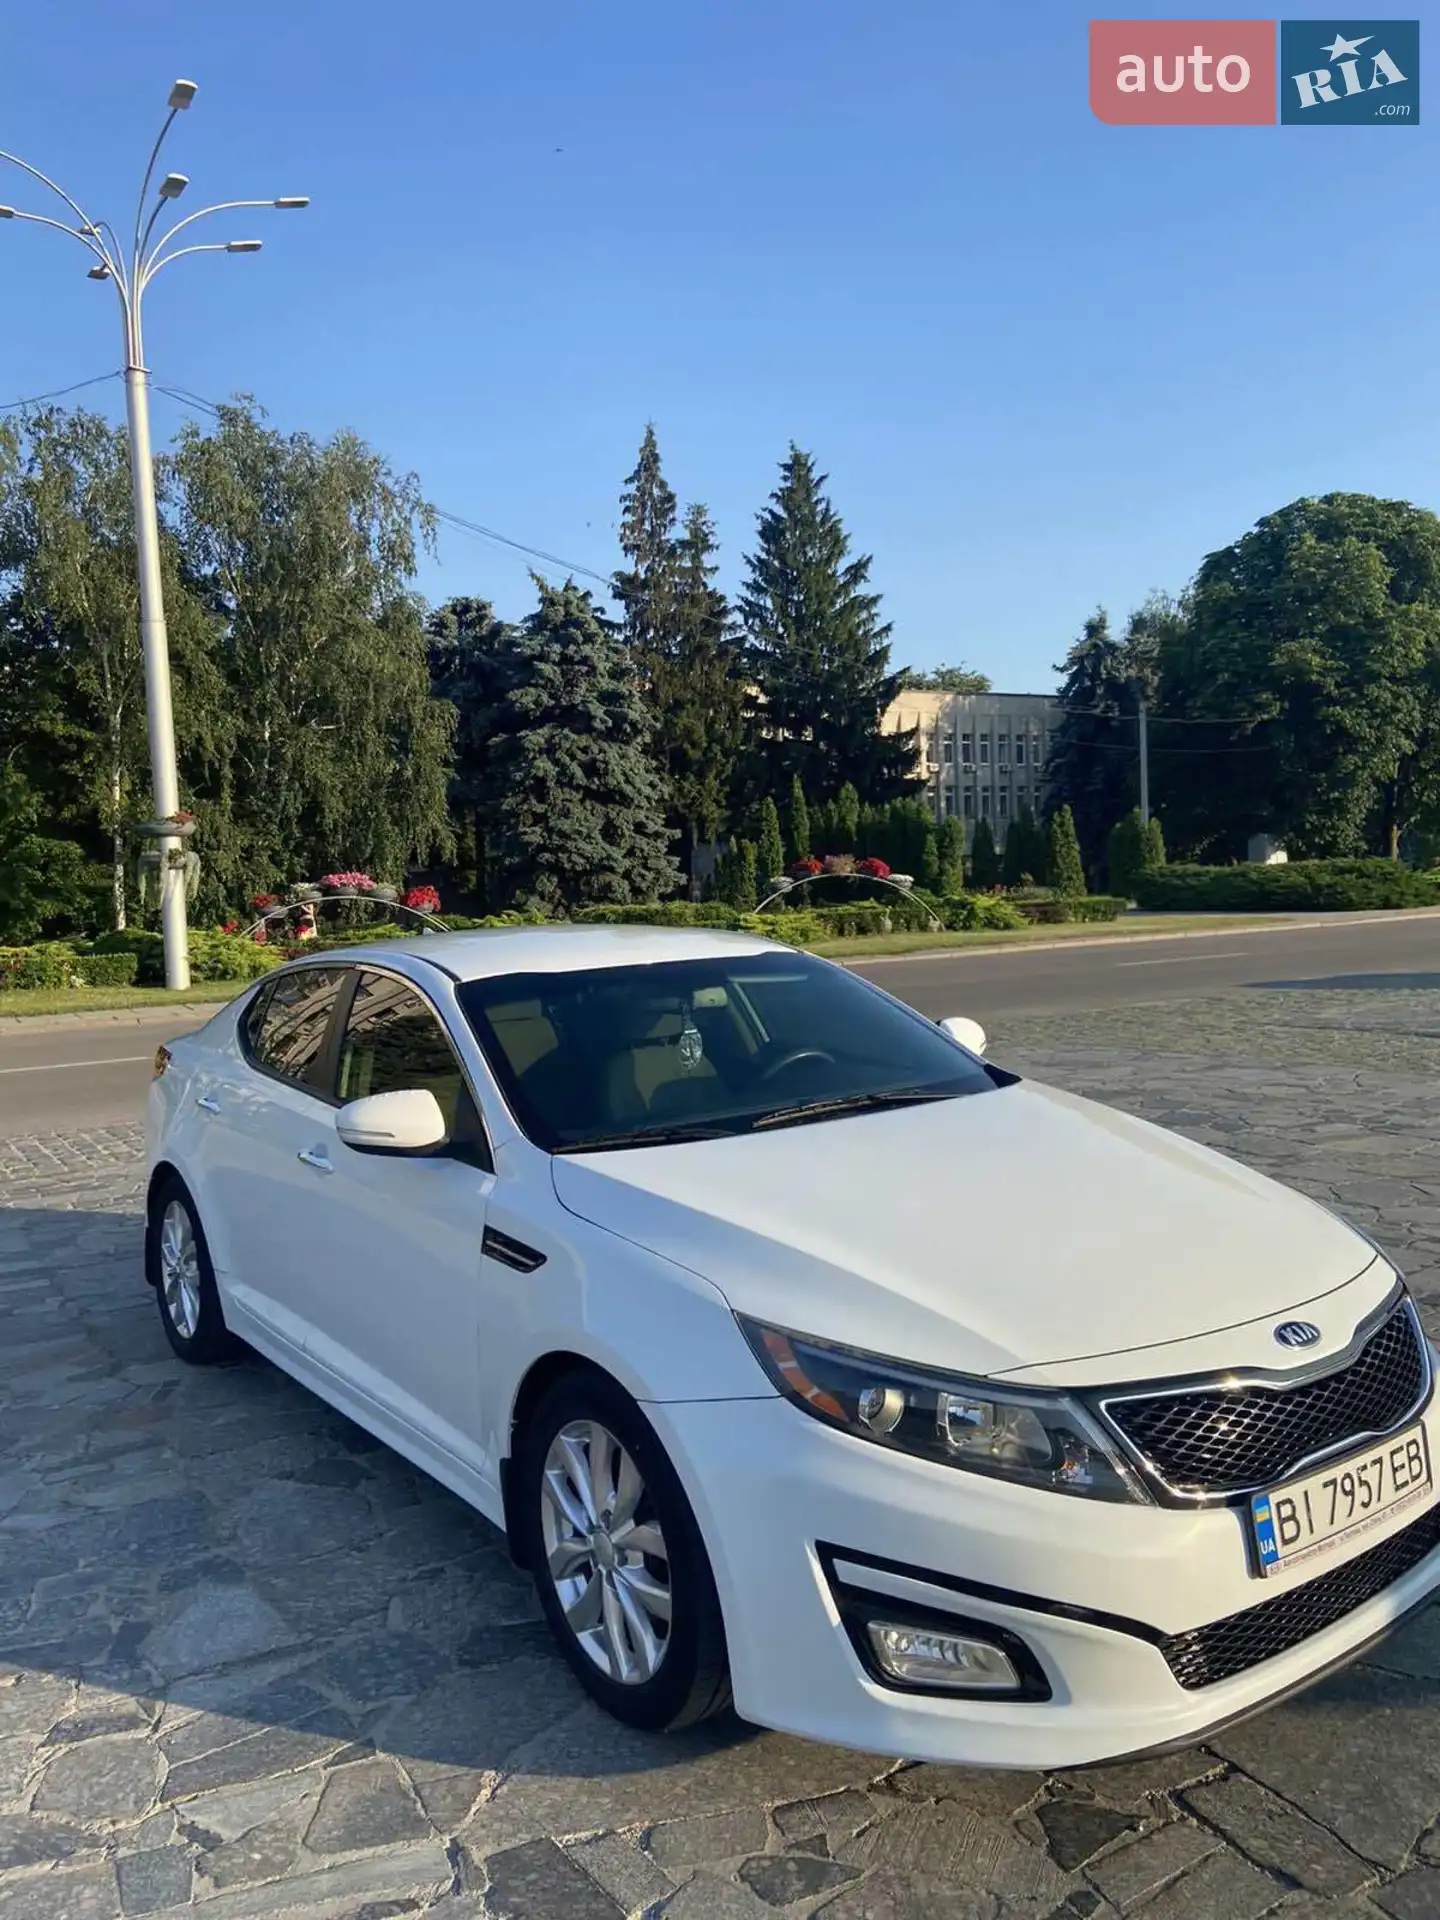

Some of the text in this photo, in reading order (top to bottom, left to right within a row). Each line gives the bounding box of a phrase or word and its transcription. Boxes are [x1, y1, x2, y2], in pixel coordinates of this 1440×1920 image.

[1279, 1323, 1319, 1345] KIA
[1274, 1490, 1315, 1546] BI
[1322, 1456, 1383, 1526] 7957
[1389, 1438, 1423, 1492] EB
[1260, 1540, 1276, 1555] UA
